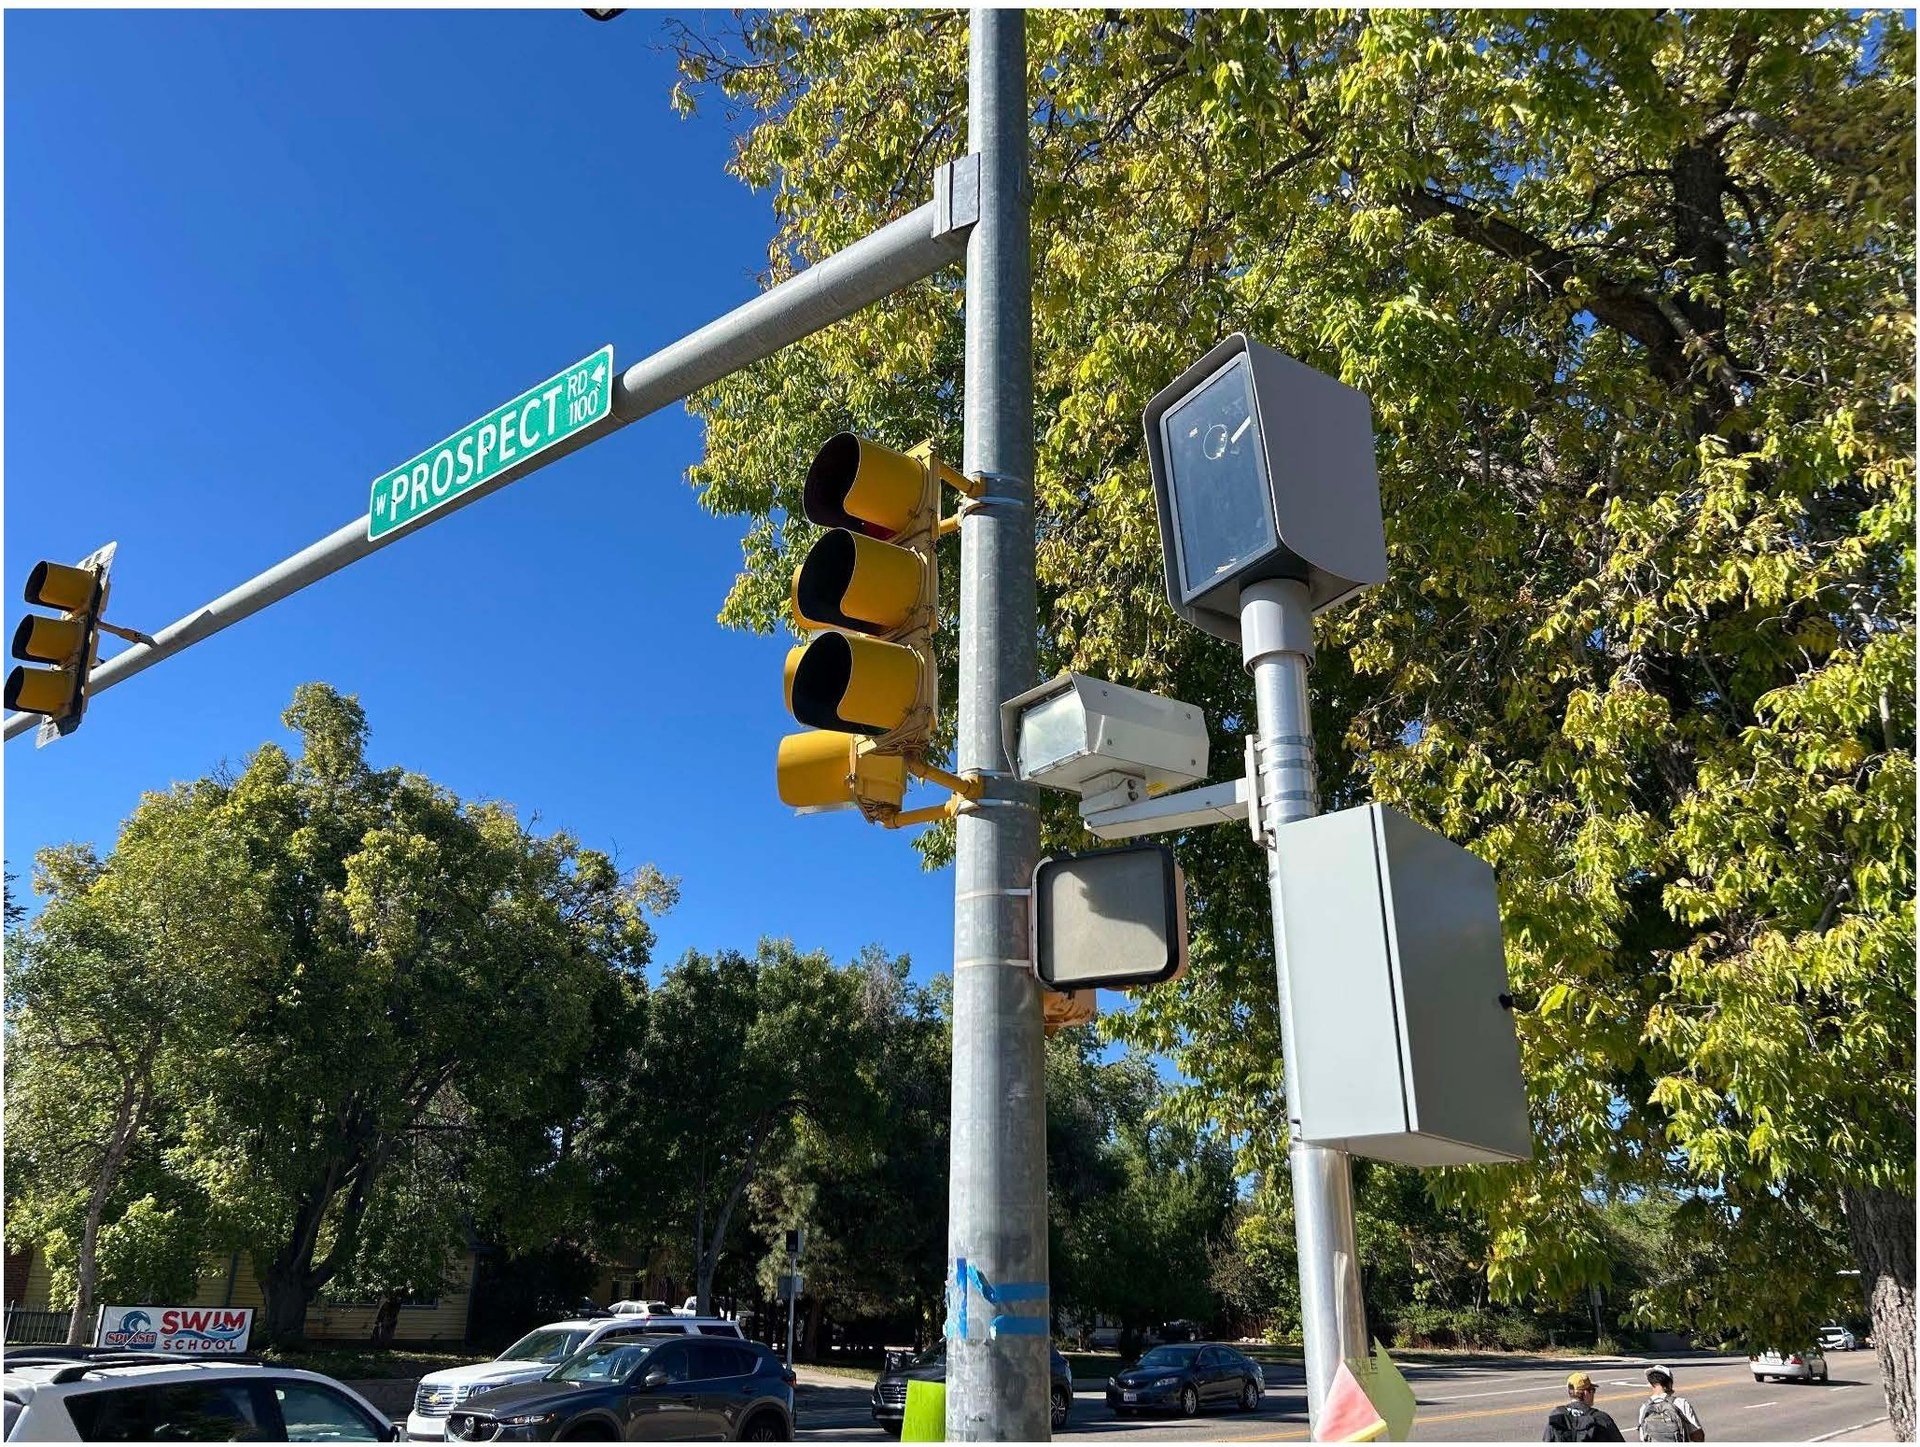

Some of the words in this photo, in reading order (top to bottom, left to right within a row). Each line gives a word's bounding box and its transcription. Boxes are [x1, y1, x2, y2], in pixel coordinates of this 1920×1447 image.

[569, 389, 599, 426] 1100
[376, 492, 387, 517] W
[390, 382, 563, 522] PROSPECT
[567, 369, 588, 401] RD
[160, 1310, 246, 1334] SWIM
[162, 1338, 237, 1351] SCHOOL
